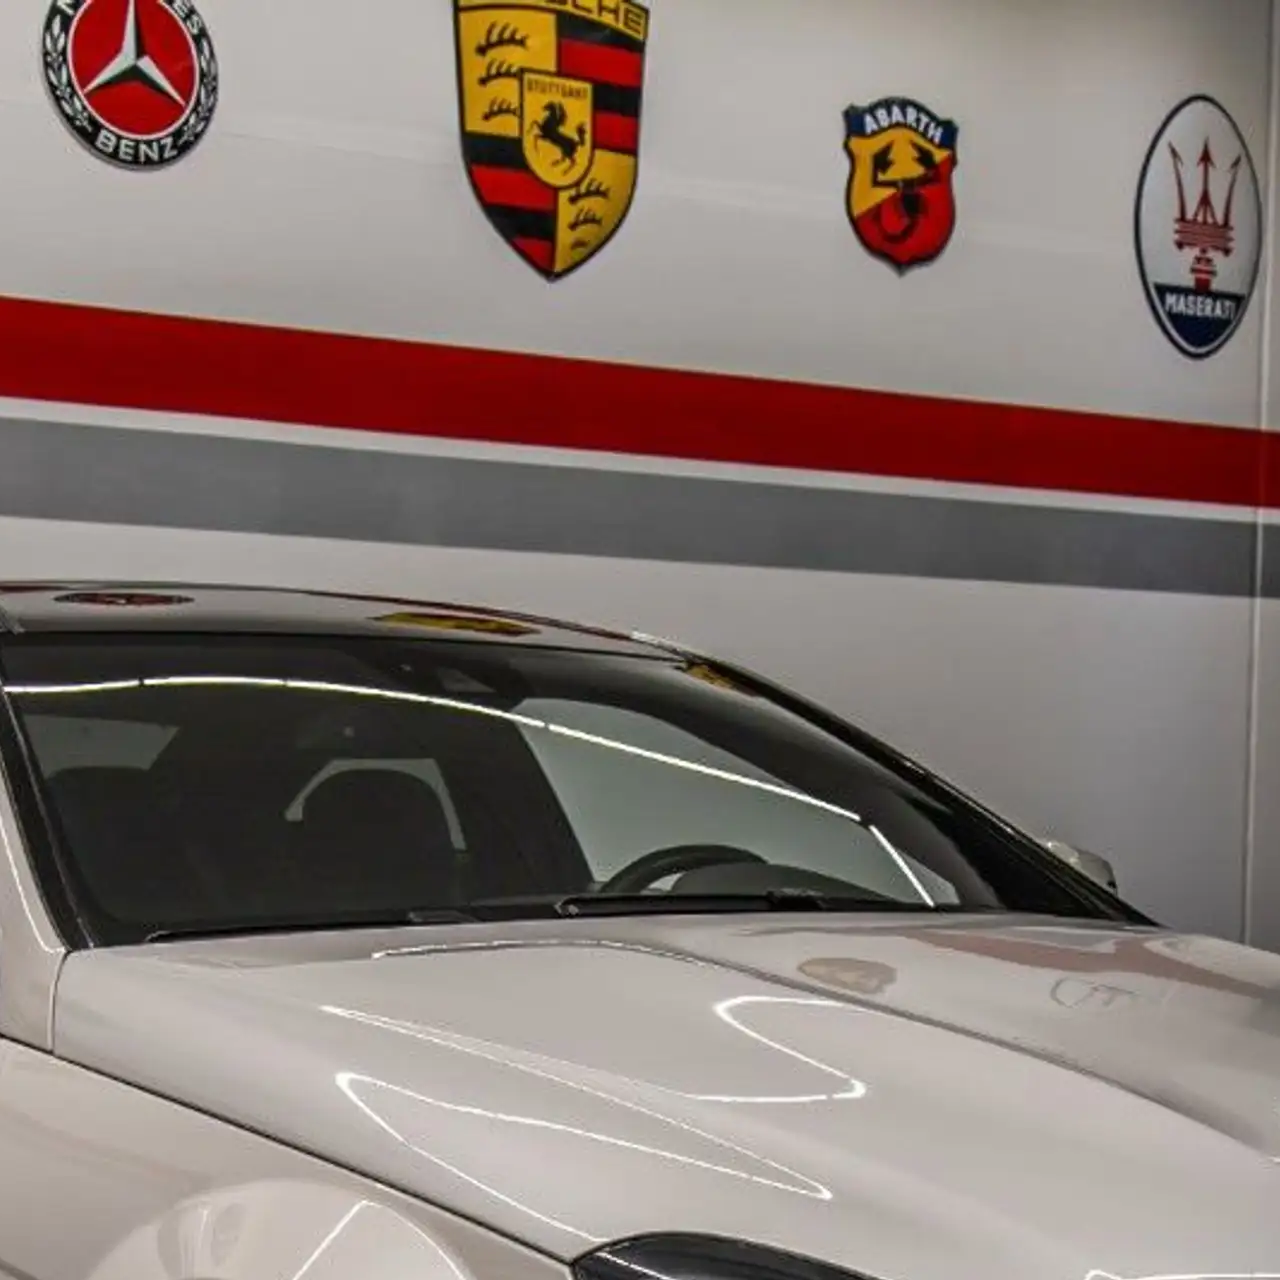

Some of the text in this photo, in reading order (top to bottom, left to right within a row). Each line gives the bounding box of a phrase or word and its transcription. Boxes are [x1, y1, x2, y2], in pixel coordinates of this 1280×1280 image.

[863, 104, 945, 144] ABARTH
[95, 128, 178, 164] BENZ
[1164, 292, 1236, 321] MASERATI
